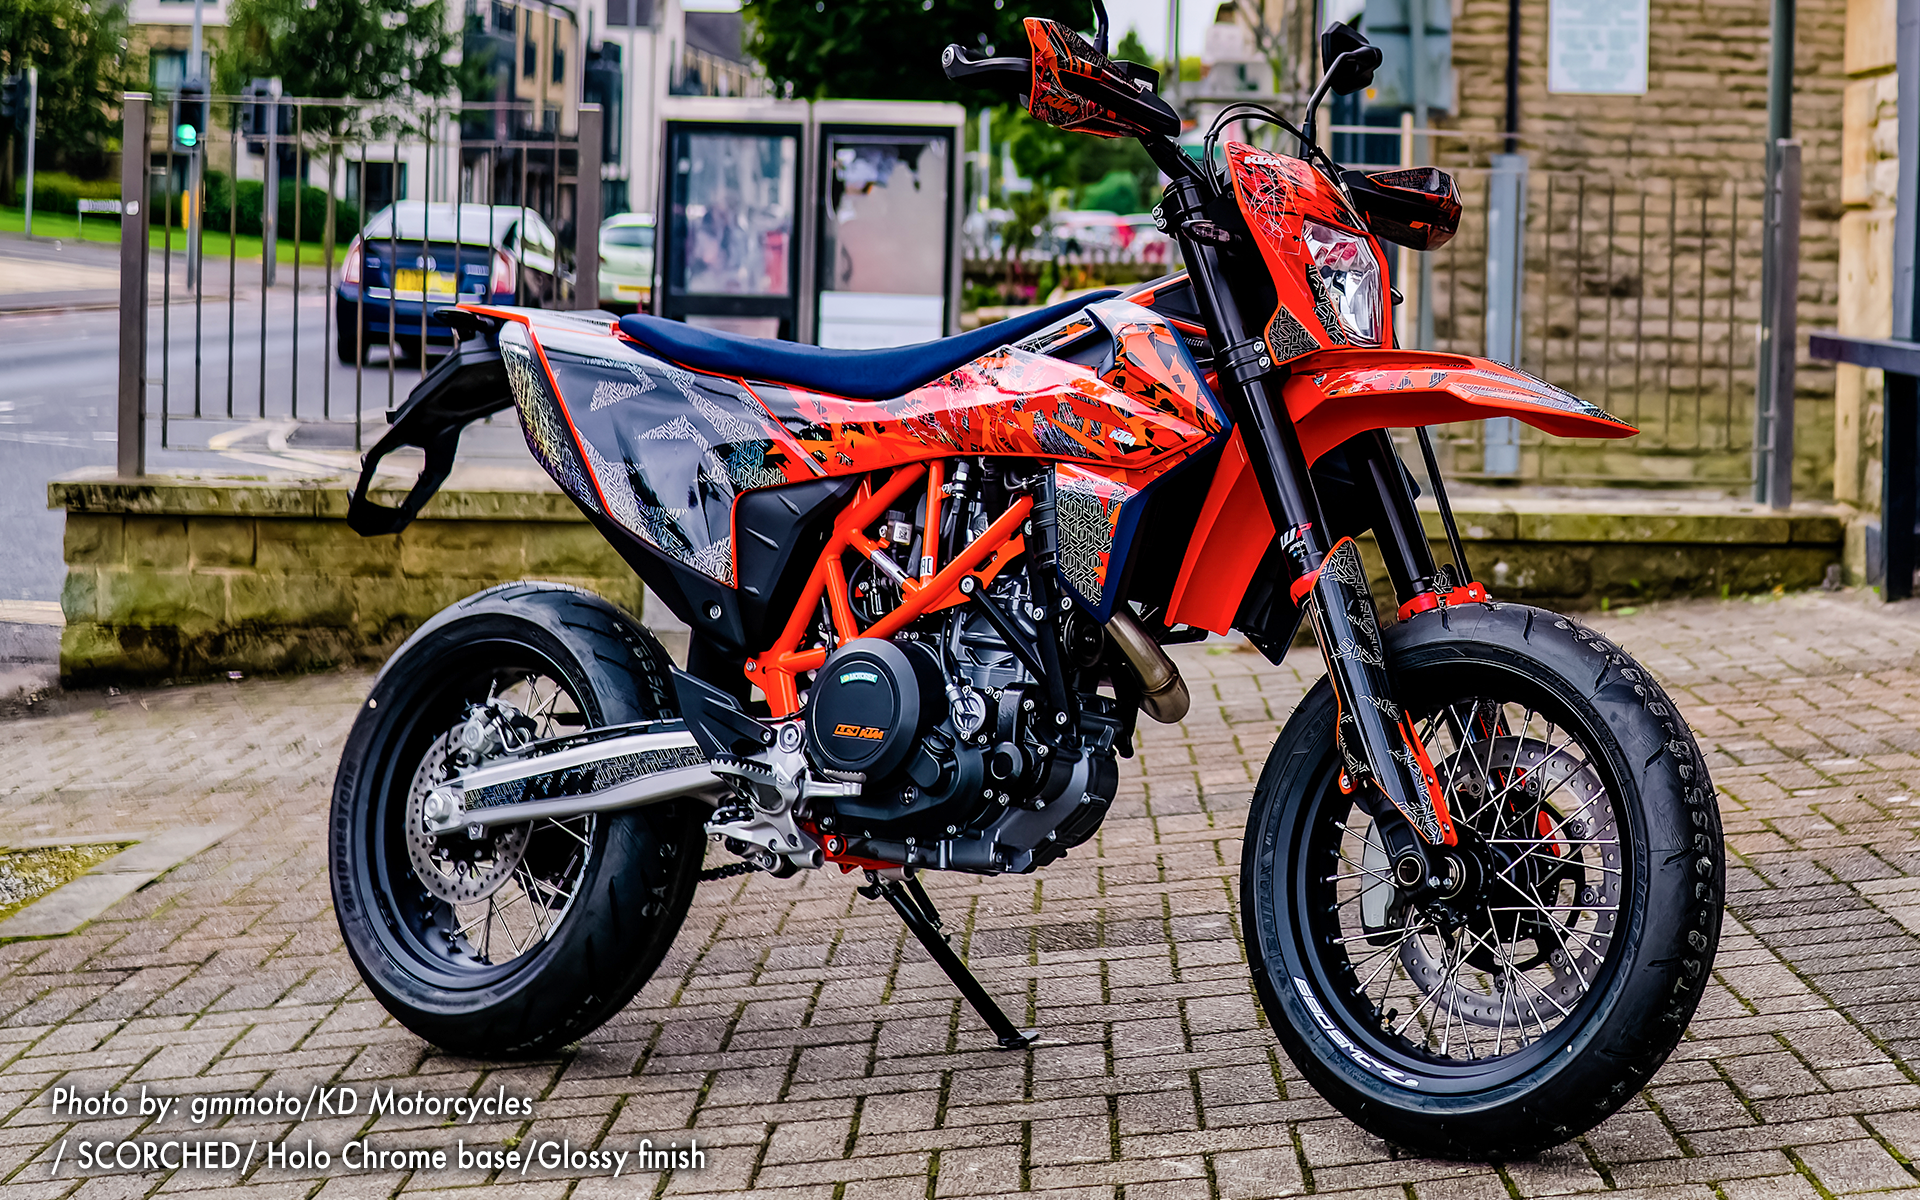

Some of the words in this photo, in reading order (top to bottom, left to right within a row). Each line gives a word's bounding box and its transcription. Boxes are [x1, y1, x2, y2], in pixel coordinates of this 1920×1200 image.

[1040, 95, 1079, 116] KTM
[1244, 155, 1281, 167] KTM
[1108, 428, 1137, 447] KTM
[859, 727, 885, 740] KTM
